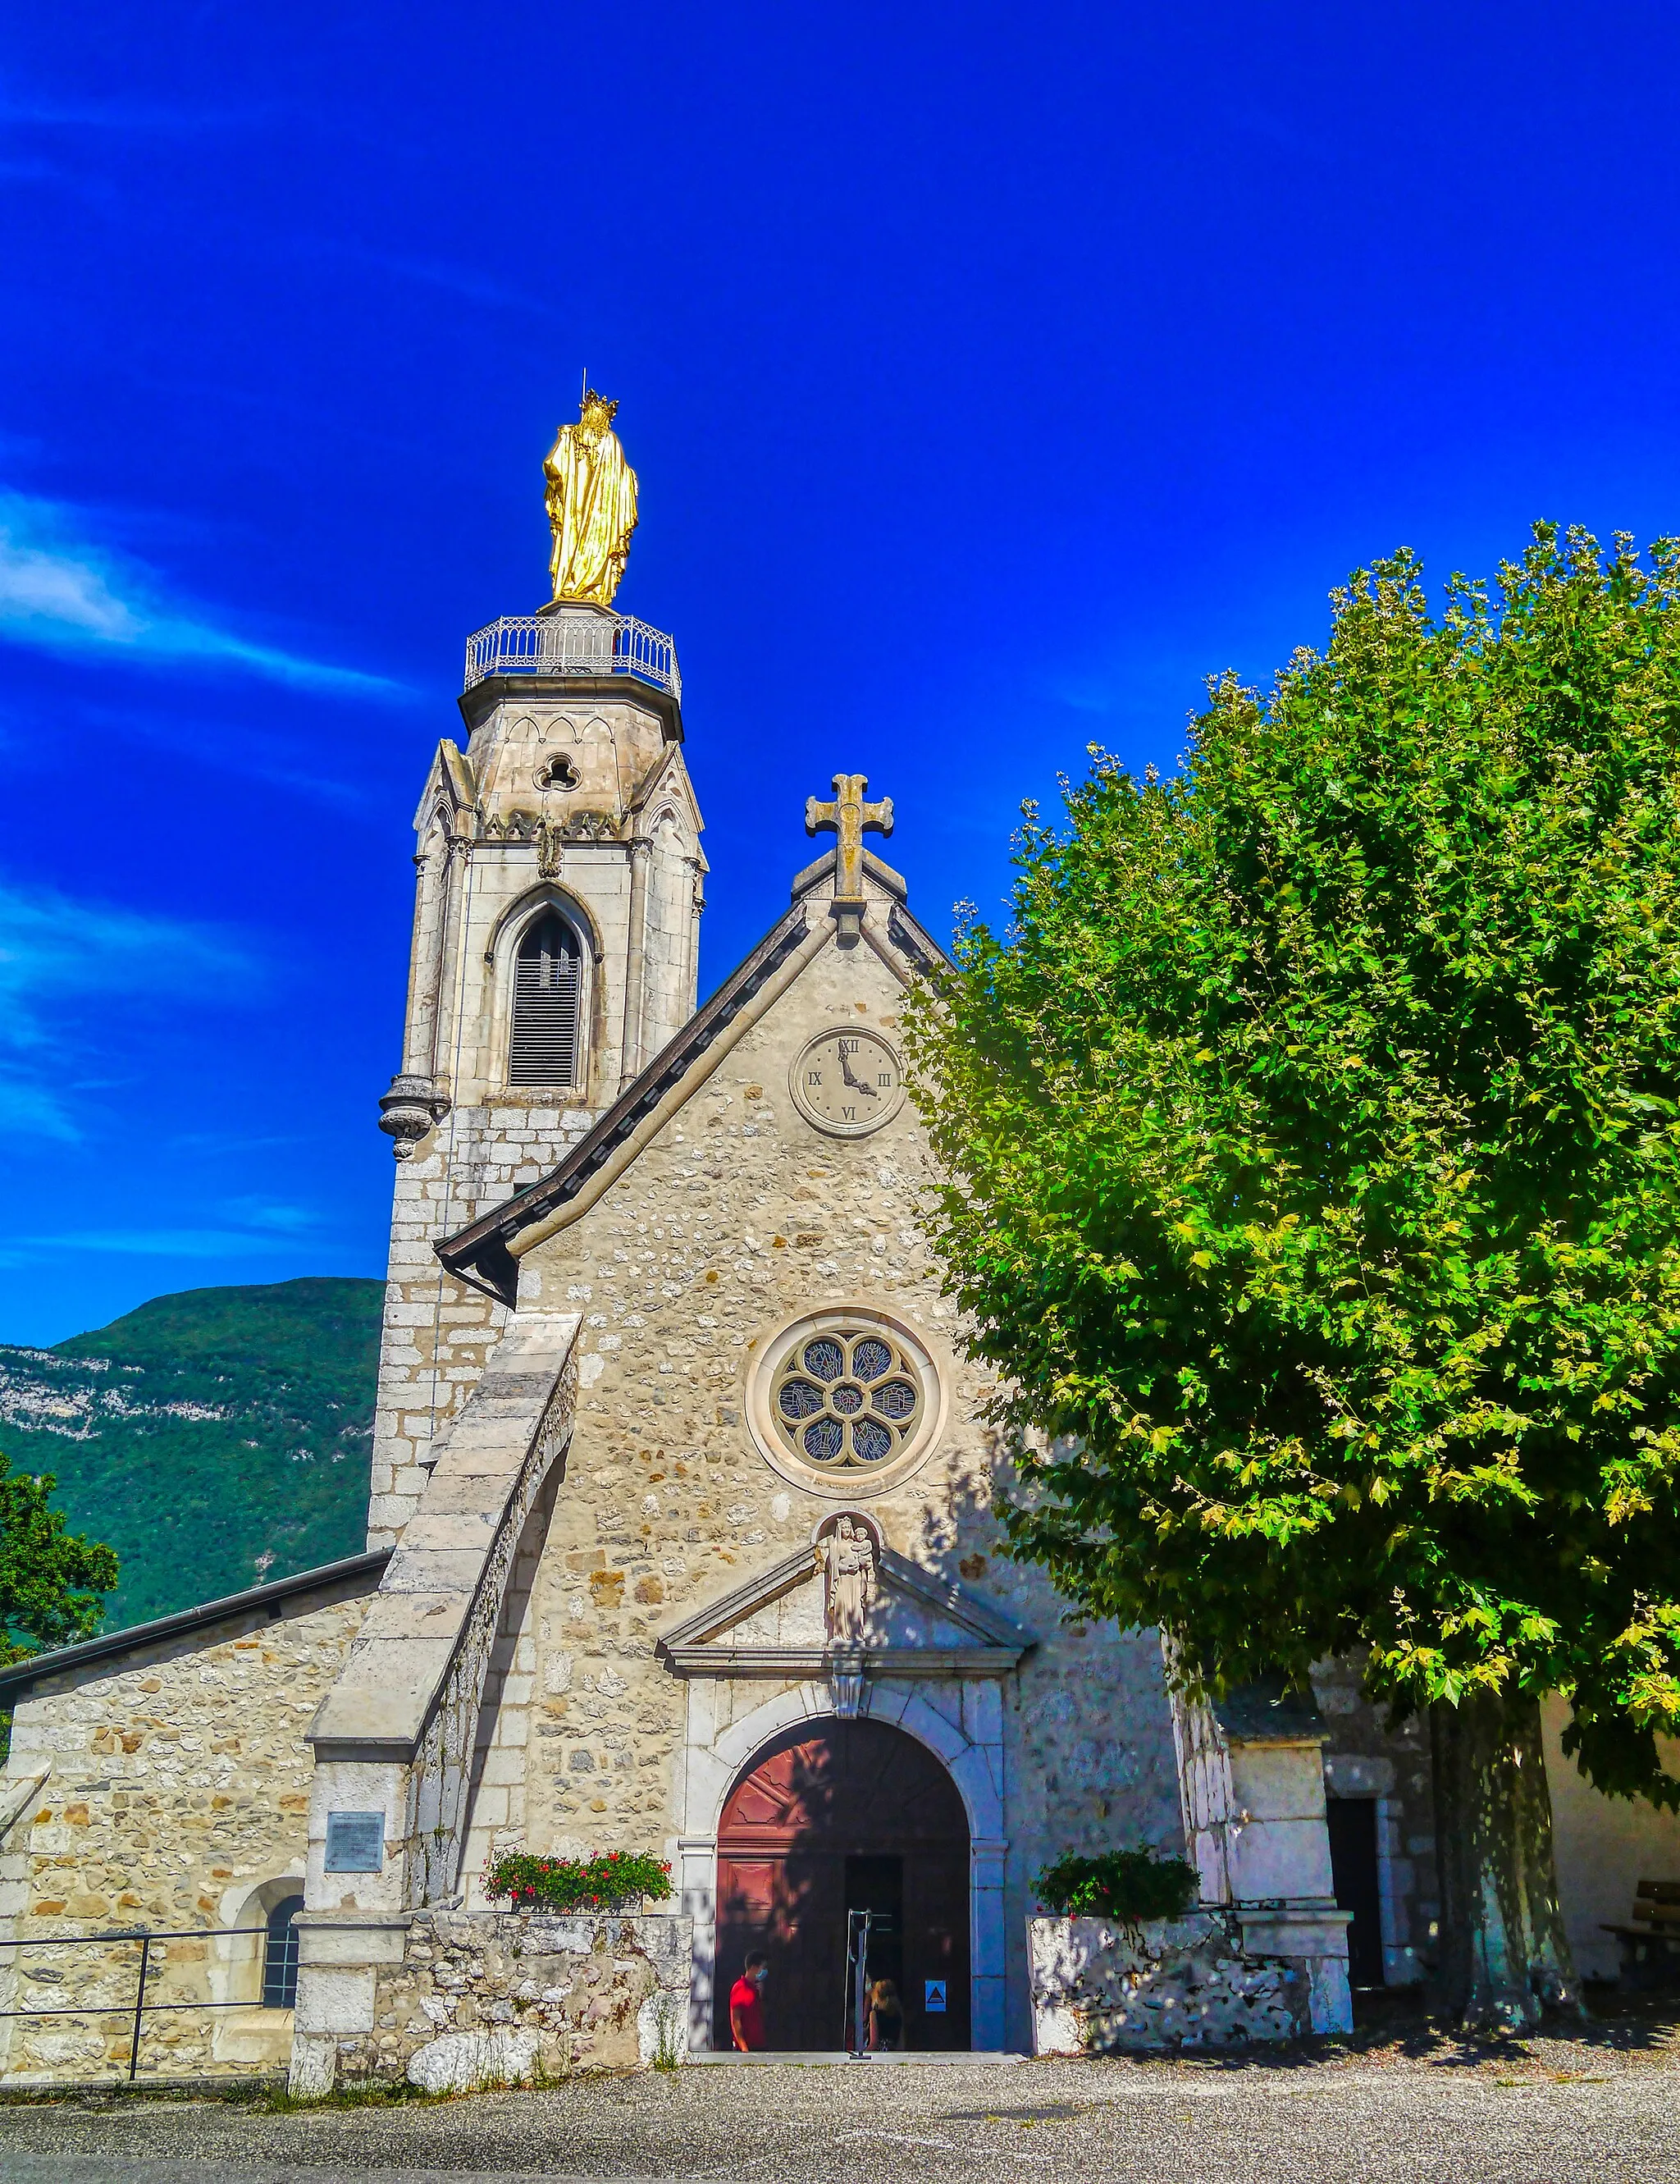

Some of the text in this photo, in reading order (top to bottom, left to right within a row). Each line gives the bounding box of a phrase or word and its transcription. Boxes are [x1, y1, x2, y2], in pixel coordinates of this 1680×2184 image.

[842, 1039, 859, 1053] XII
[808, 1071, 822, 1085] IX
[878, 1073, 892, 1087] III
[842, 1107, 856, 1121] VI
